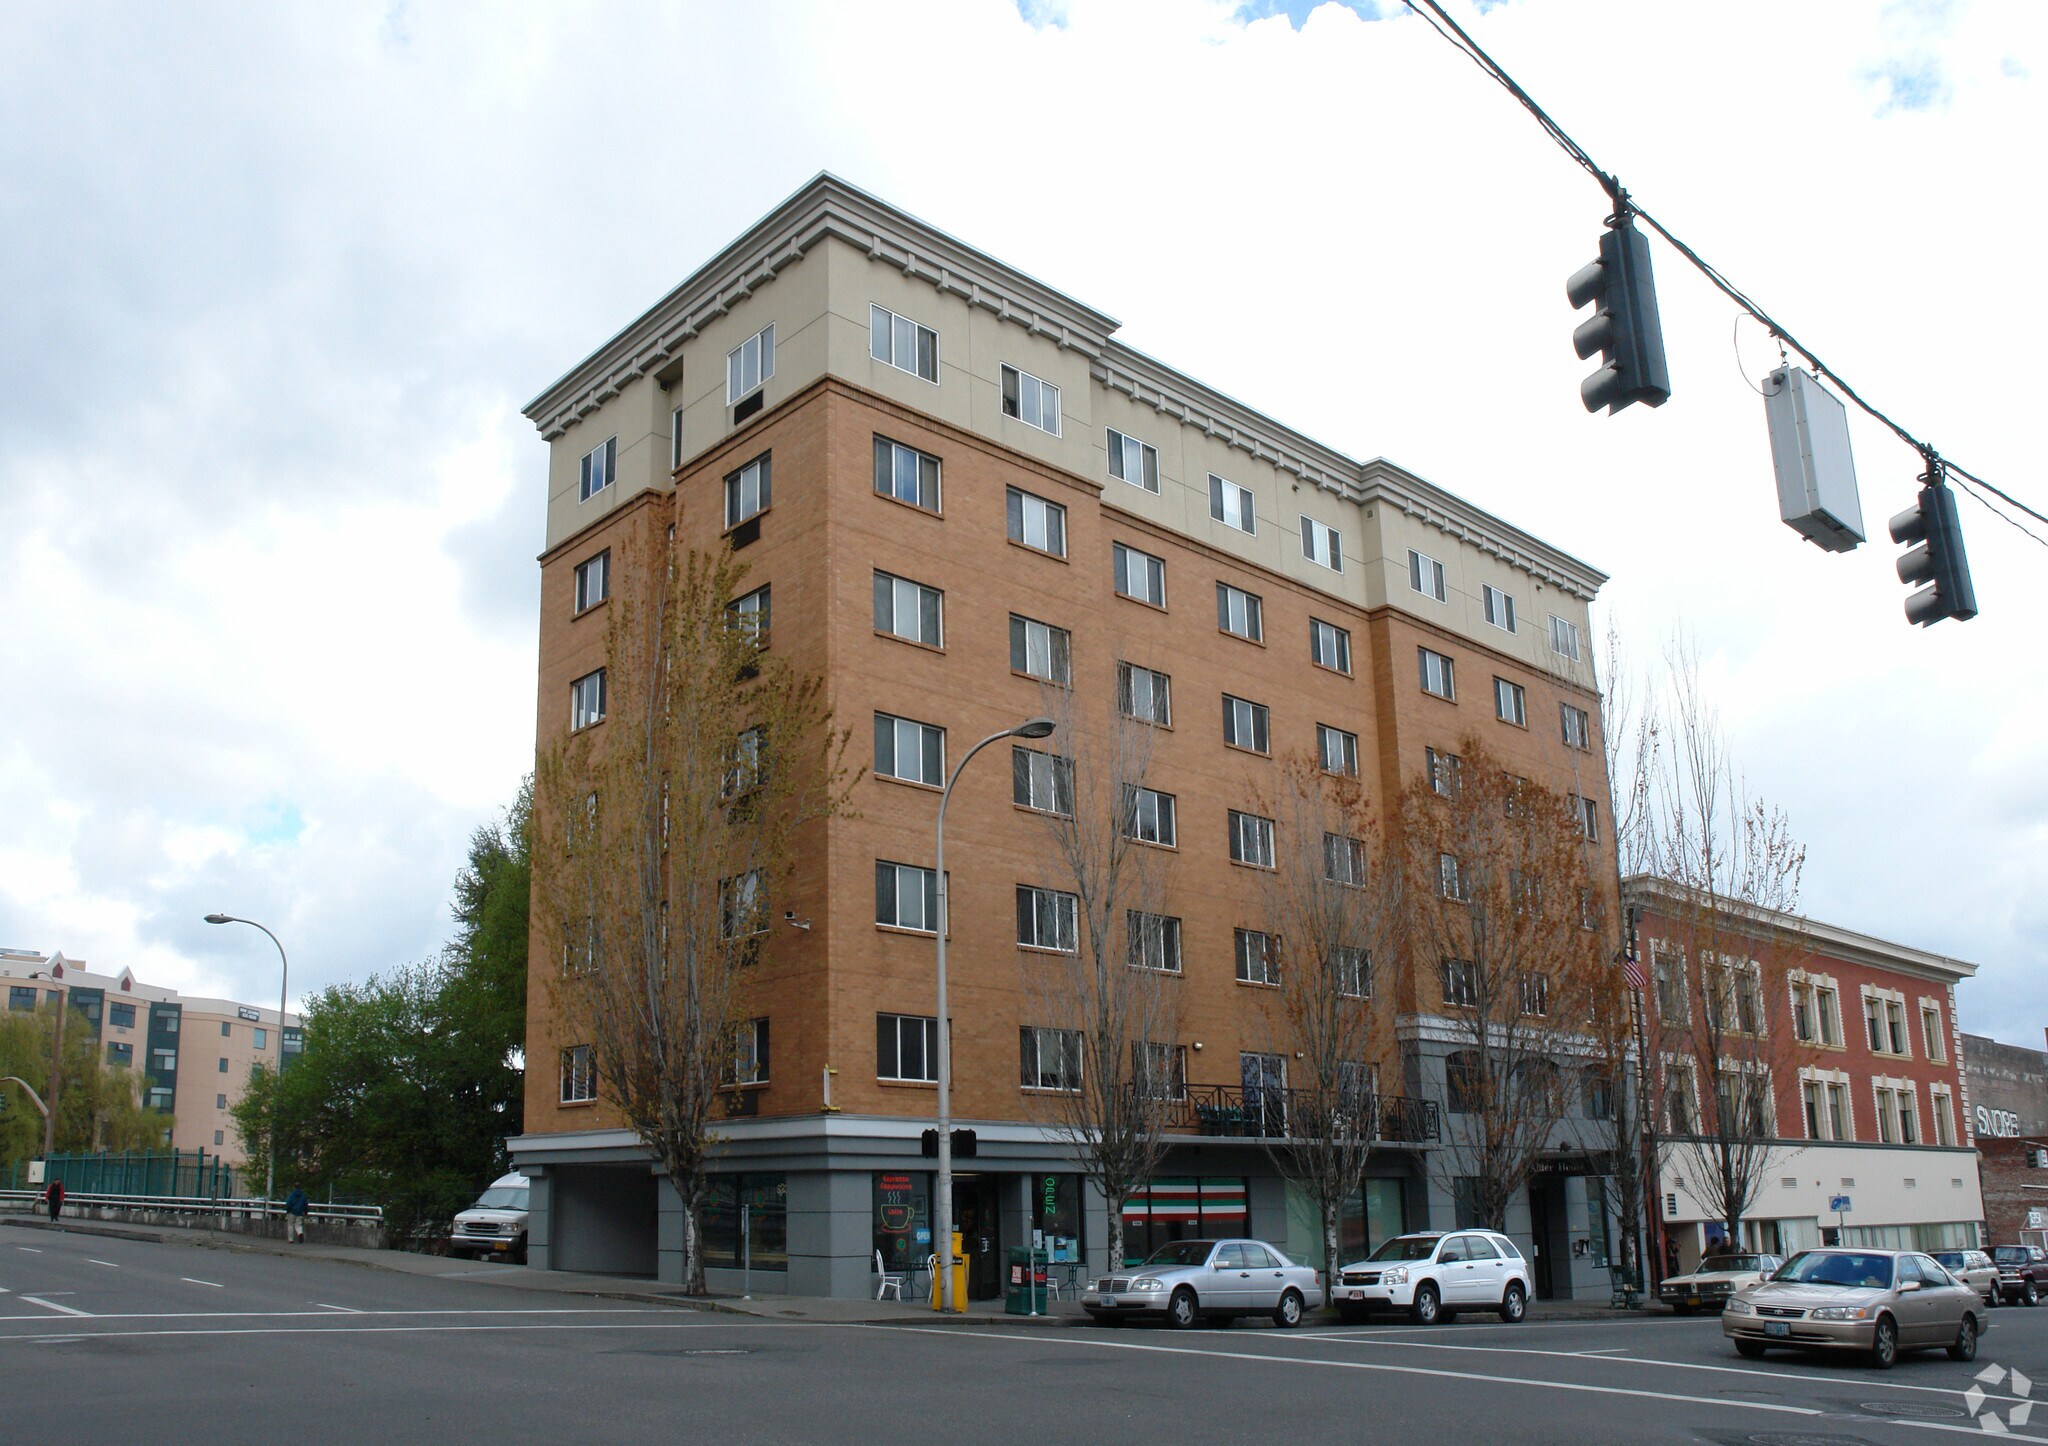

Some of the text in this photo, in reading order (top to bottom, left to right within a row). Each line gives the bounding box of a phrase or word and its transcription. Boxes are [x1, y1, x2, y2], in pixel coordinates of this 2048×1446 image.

[1976, 1104, 2020, 1138] SNORE
[1045, 1177, 1056, 1215] OPEN
[916, 1231, 930, 1241] OPEN
